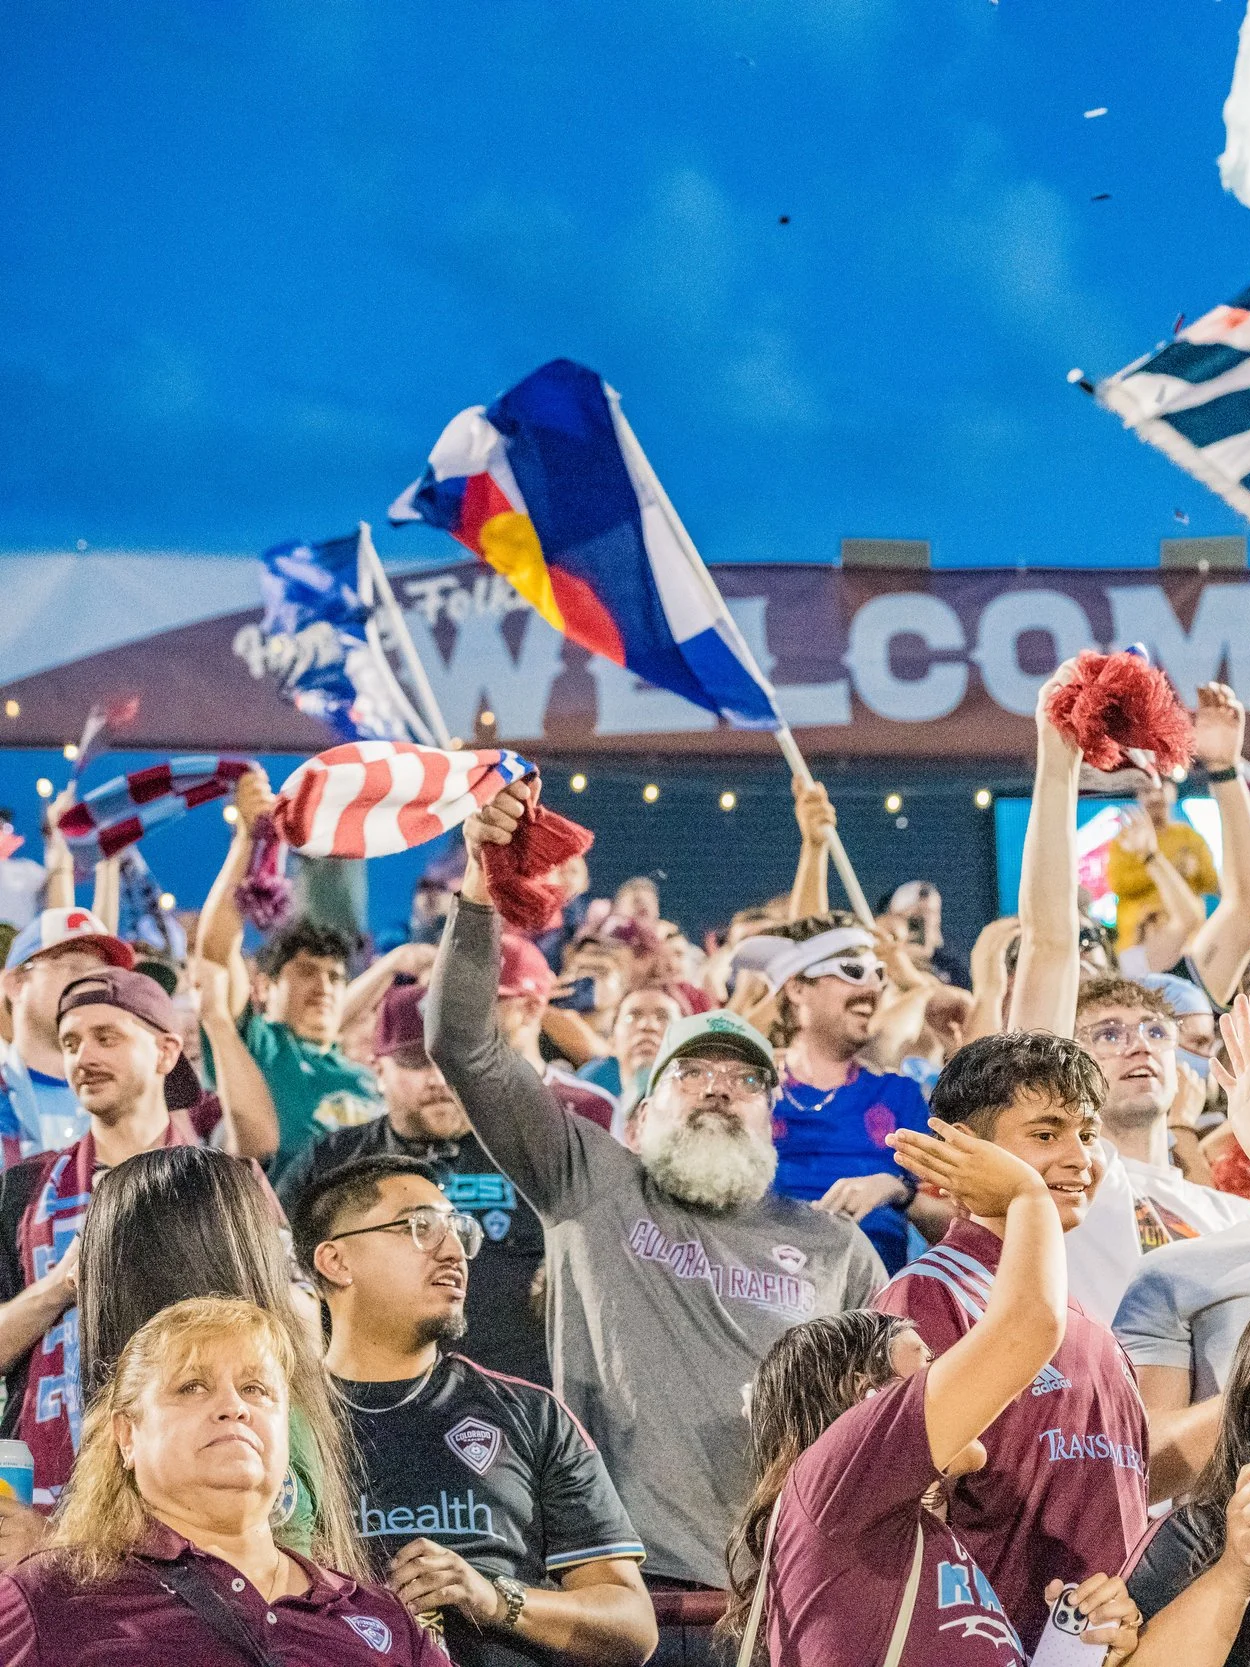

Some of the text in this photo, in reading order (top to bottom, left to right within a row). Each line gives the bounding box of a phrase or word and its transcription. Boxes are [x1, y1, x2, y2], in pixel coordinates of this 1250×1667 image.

[629, 1218, 816, 1314] COLORAO RAPIDS
[1031, 1378, 1073, 1397] adidas
[455, 1429, 492, 1442] COLORADO
[352, 1488, 493, 1537] health
